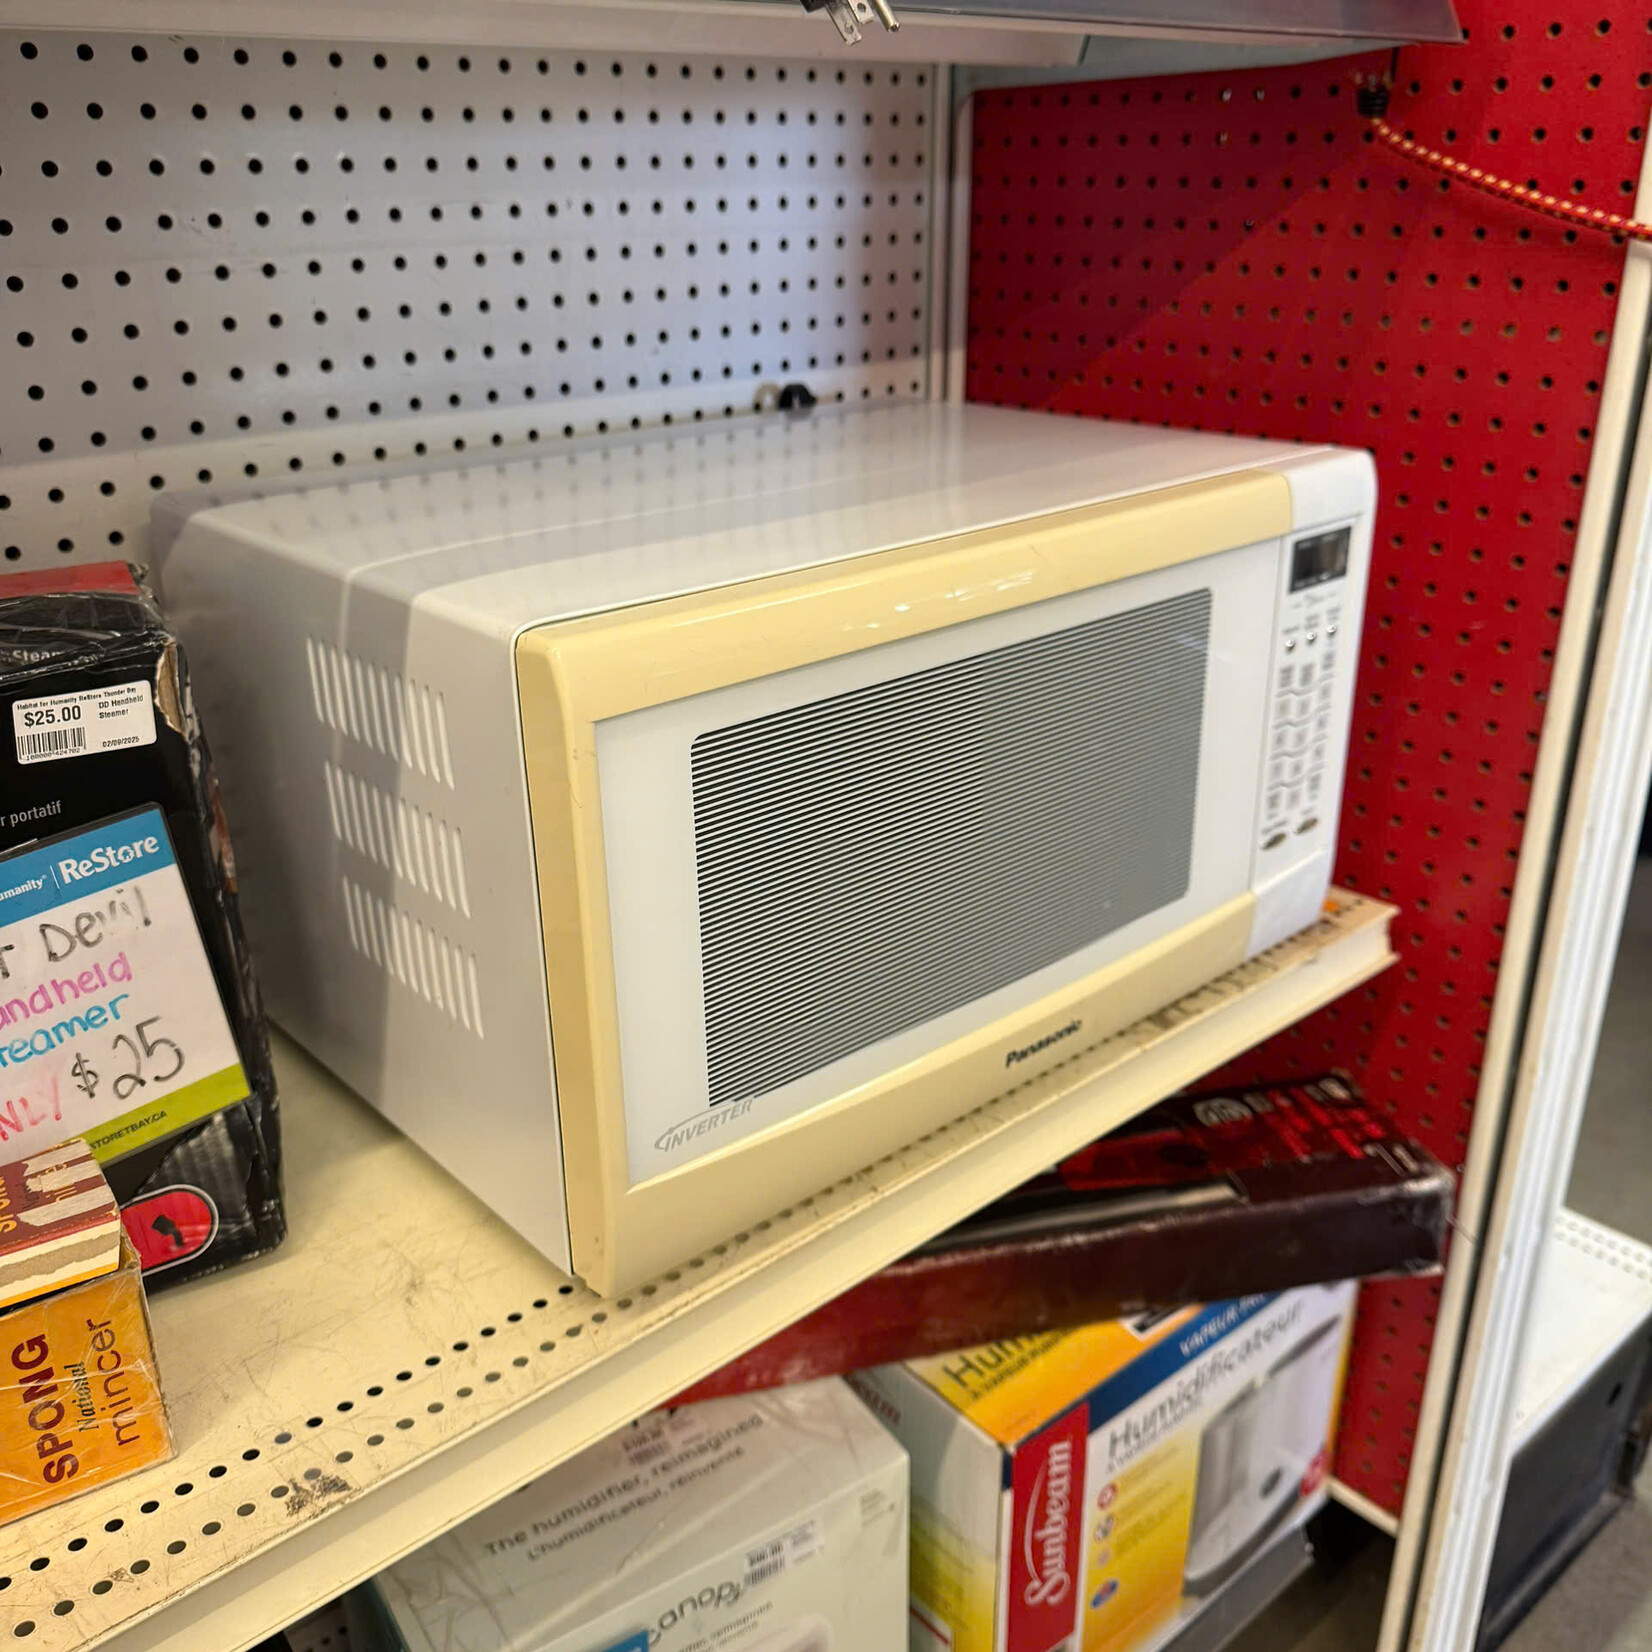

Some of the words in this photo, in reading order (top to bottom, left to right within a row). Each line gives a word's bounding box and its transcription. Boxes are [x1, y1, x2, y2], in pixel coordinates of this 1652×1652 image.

[24, 705, 82, 728] $25.00
[99, 708, 129, 719] Steamer
[10, 800, 62, 828] portatif
[58, 836, 160, 884] ReStore
[1004, 1017, 1082, 1069] Panasonic
[662, 1098, 755, 1152] INVERTER
[64, 1361, 99, 1433] National
[86, 1318, 140, 1447] mincer
[1108, 1298, 1306, 1458] Humidificateur
[11, 1333, 79, 1484] SPONG
[485, 1530, 528, 1556] The
[1024, 1440, 1073, 1607] Sunbeam
